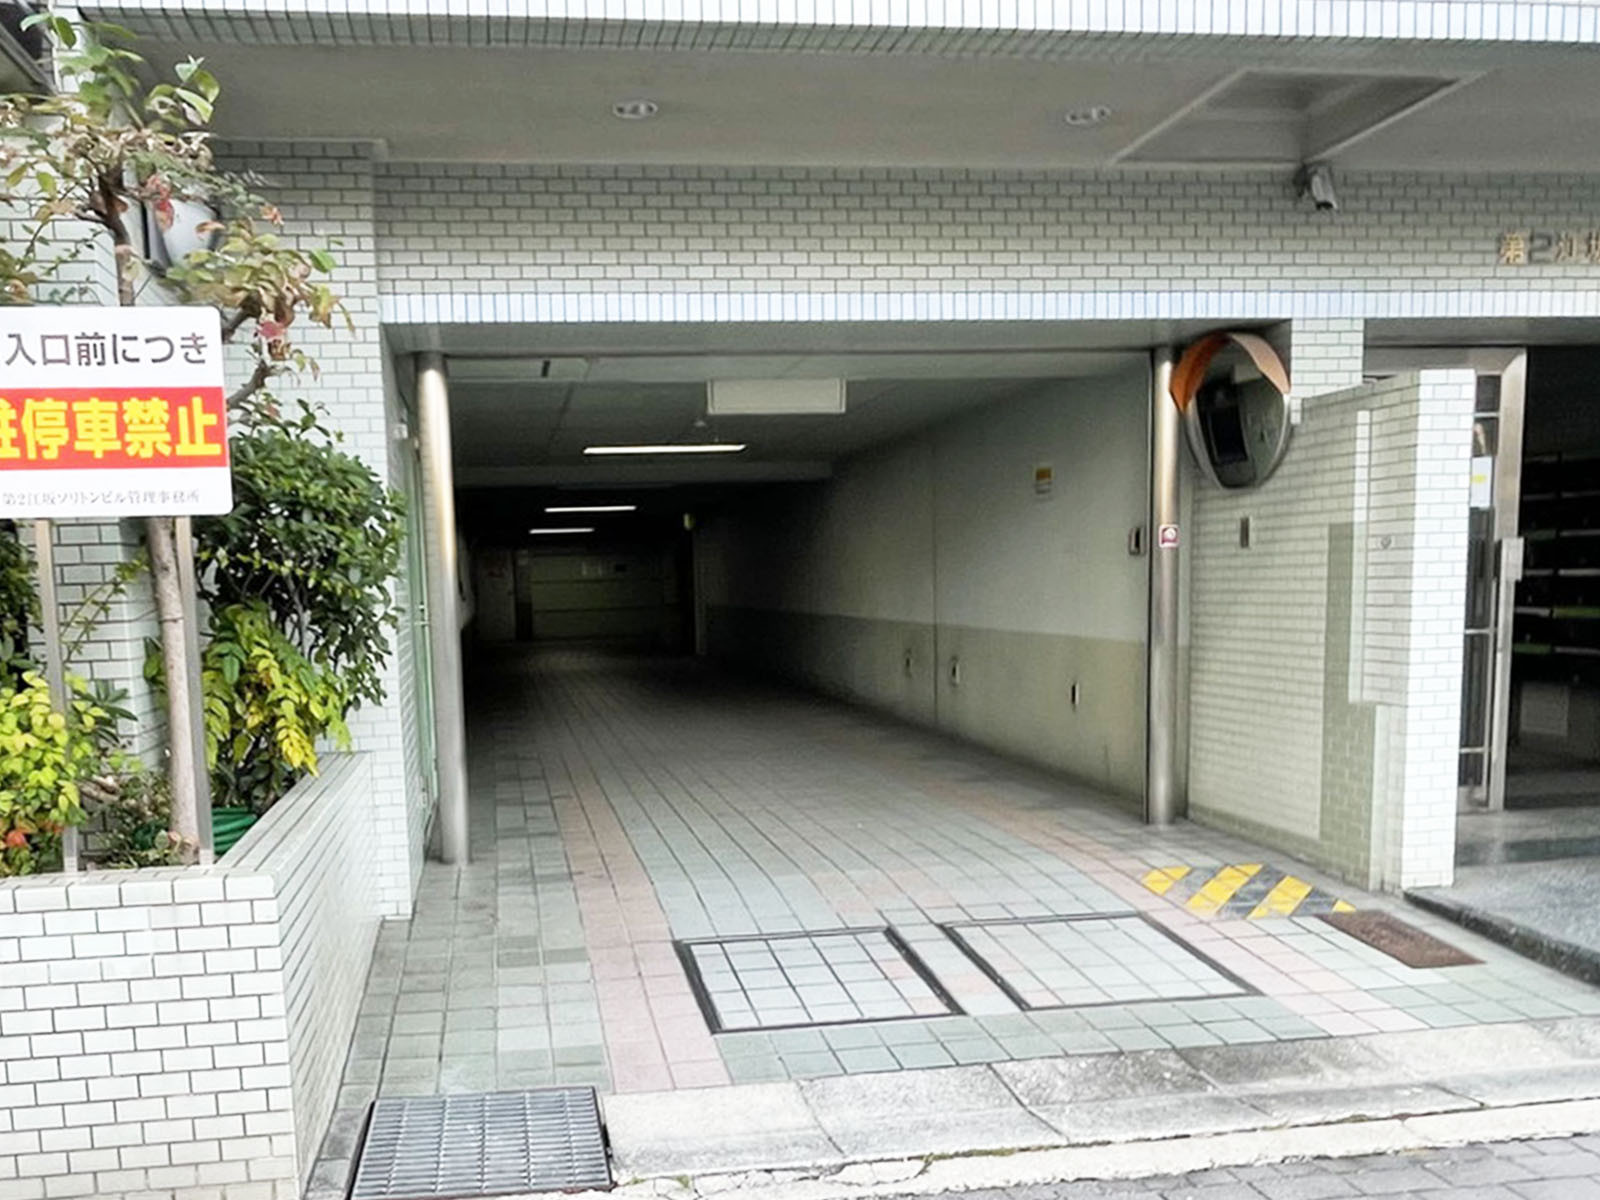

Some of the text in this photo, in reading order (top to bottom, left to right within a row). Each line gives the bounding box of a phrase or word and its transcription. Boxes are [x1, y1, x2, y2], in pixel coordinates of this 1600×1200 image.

[5, 331, 208, 366] 入口前につき
